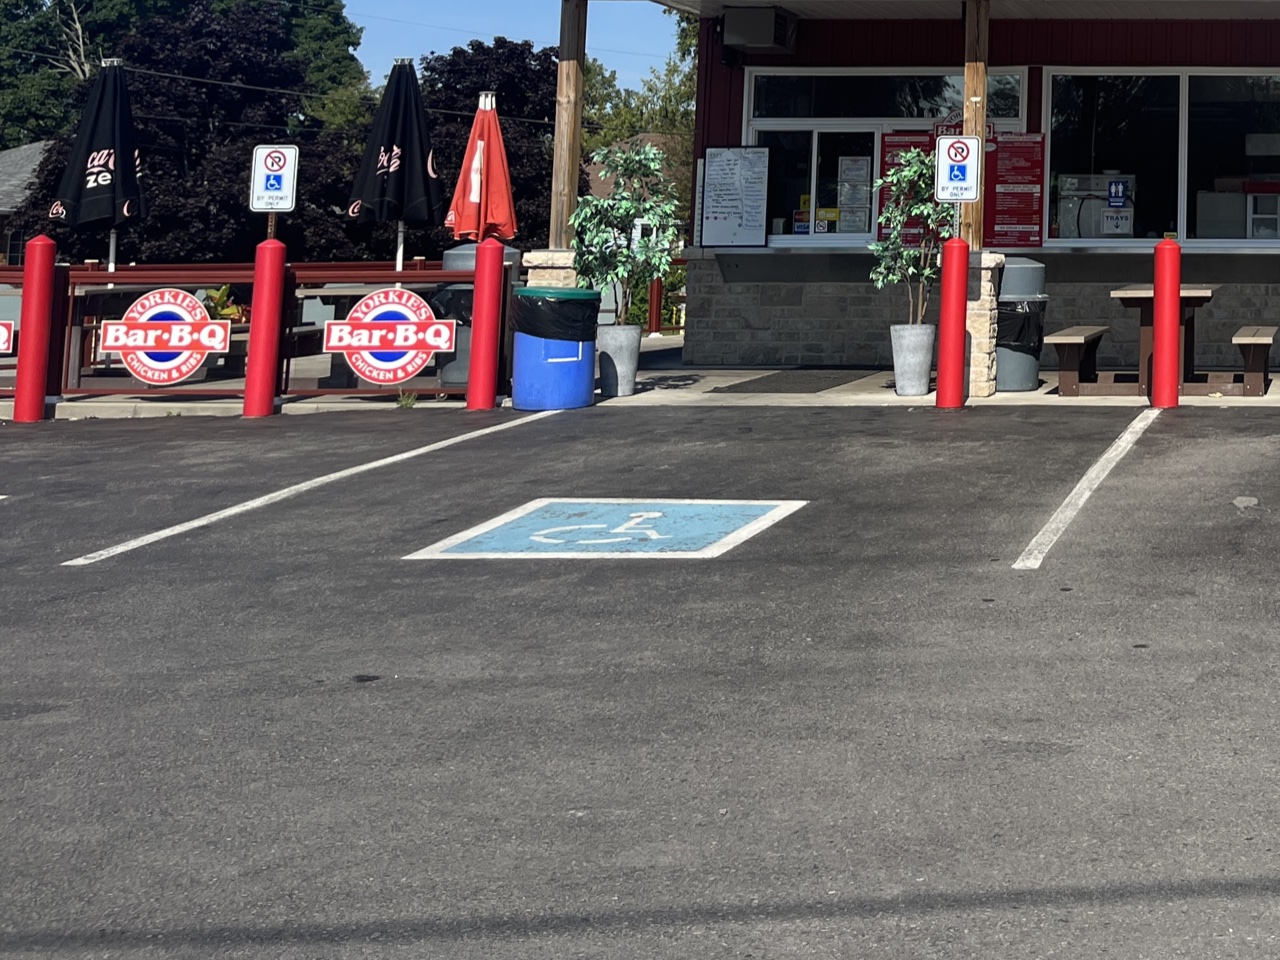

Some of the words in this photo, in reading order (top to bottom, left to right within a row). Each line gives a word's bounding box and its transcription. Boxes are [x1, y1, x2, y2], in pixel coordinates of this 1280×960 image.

[127, 291, 204, 321] YORKIE'S
[351, 291, 431, 321] YORKIE'S
[126, 353, 168, 381] CHICKEN
[171, 368, 180, 379] &
[180, 352, 202, 374] RIBS
[351, 353, 394, 380] CHICKEN
[396, 368, 406, 379] &
[405, 352, 428, 374] RIBS
